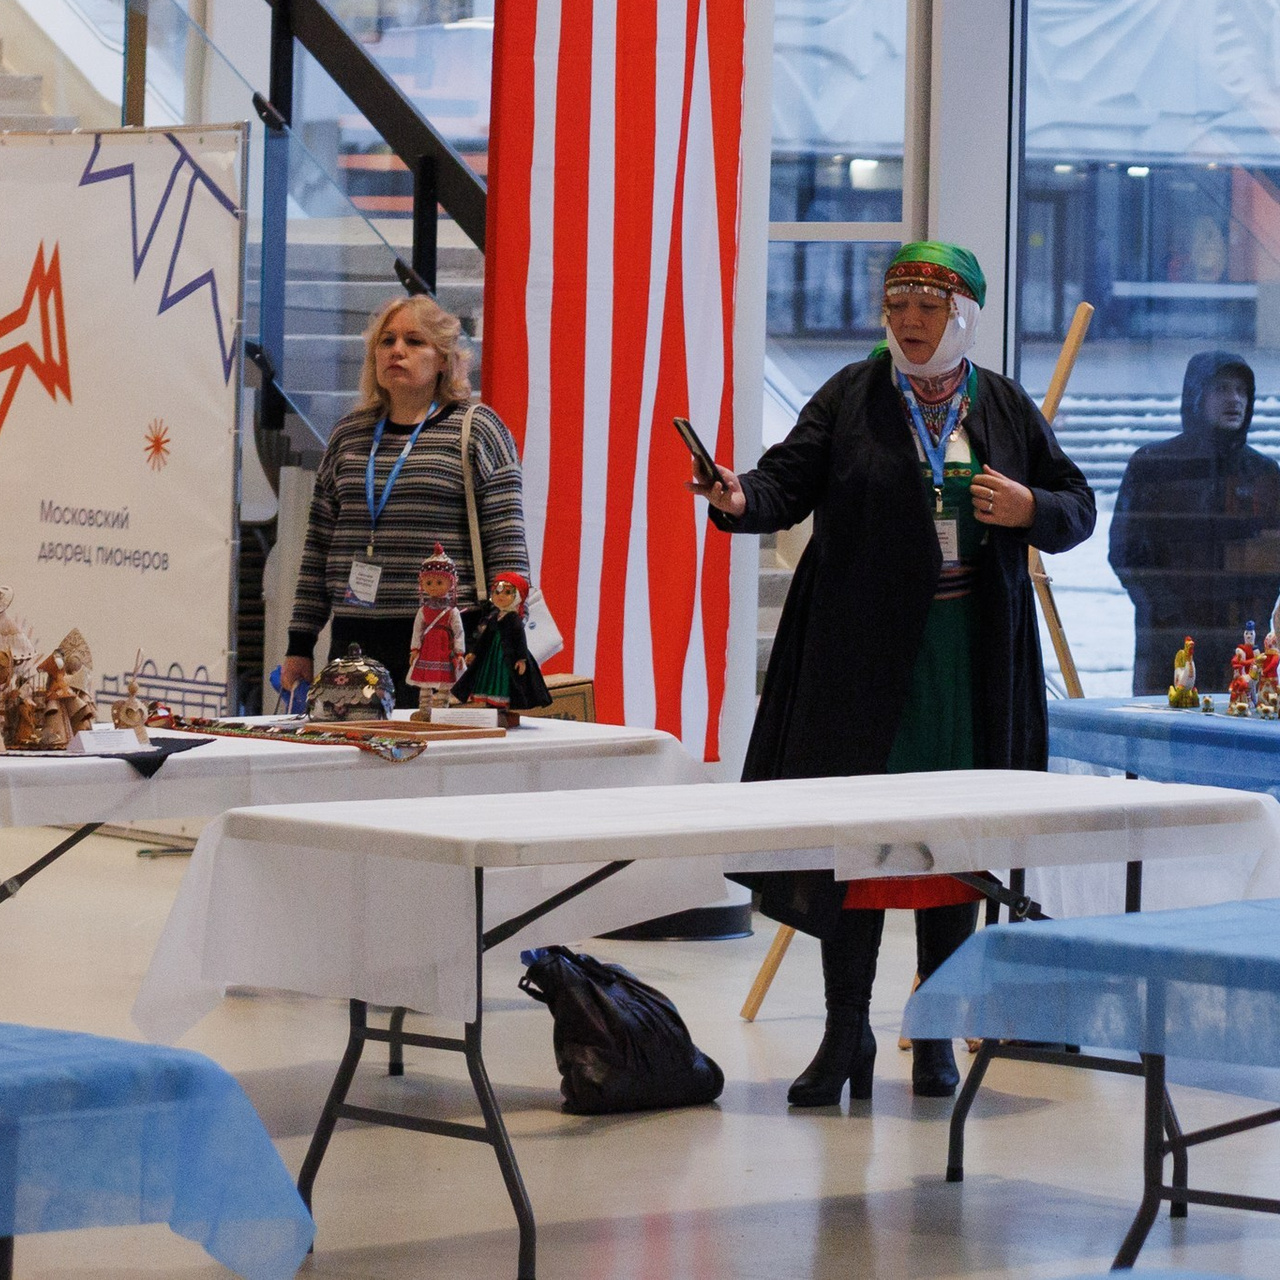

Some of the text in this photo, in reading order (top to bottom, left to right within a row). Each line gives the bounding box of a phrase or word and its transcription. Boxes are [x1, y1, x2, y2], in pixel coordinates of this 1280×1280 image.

[40, 500, 129, 529] Московский
[38, 542, 169, 574] дворец пионеров
